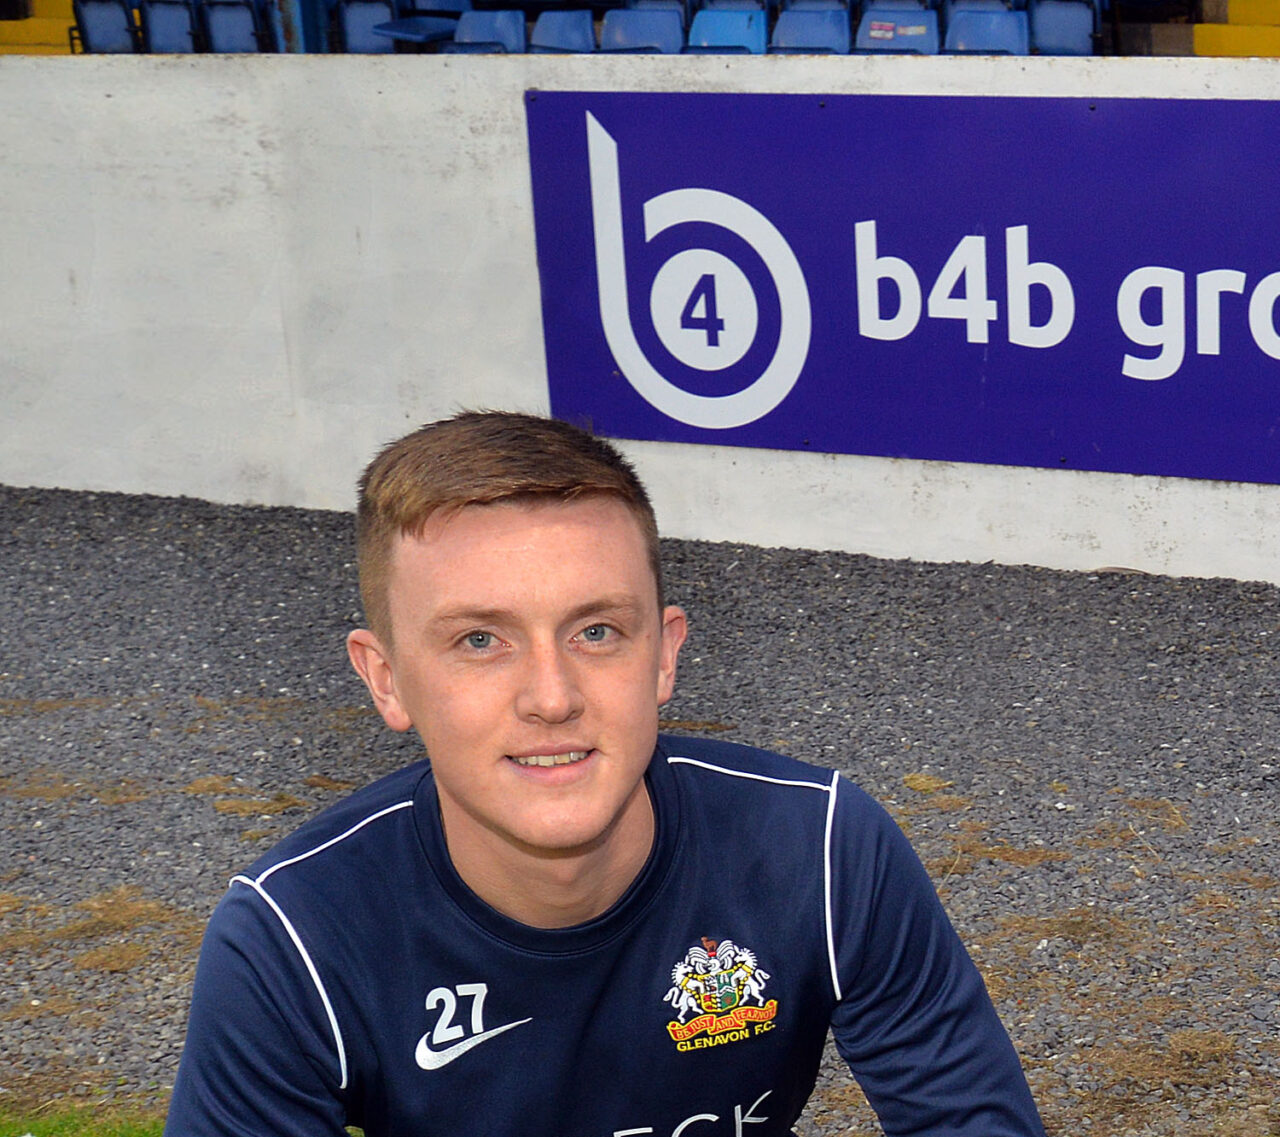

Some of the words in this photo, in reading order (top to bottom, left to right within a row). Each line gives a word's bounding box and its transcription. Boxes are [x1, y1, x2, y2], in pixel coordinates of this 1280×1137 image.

[855, 221, 1074, 348] b4b
[426, 984, 487, 1044] 27
[676, 1029, 750, 1052] GLENAVON
[754, 1021, 777, 1036] F.C.
[716, 1016, 734, 1031] AND
